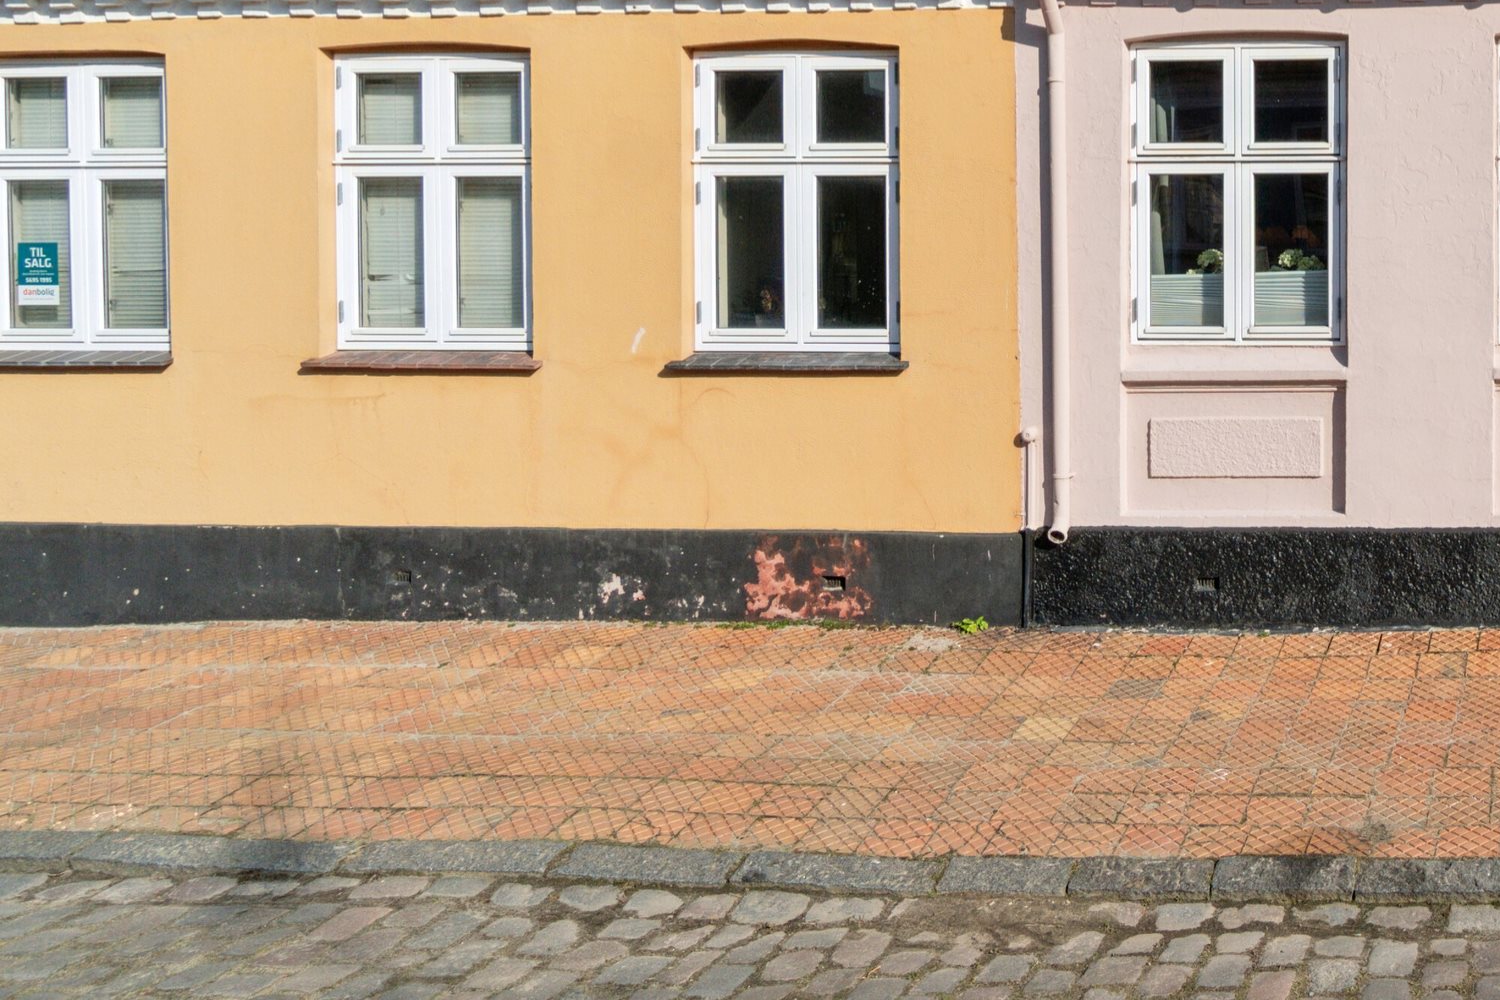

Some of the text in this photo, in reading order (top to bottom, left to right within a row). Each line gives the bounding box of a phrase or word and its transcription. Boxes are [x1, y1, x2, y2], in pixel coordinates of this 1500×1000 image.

[29, 247, 46, 257] TIL
[24, 258, 52, 268] SALG
[23, 288, 55, 296] danbolig
